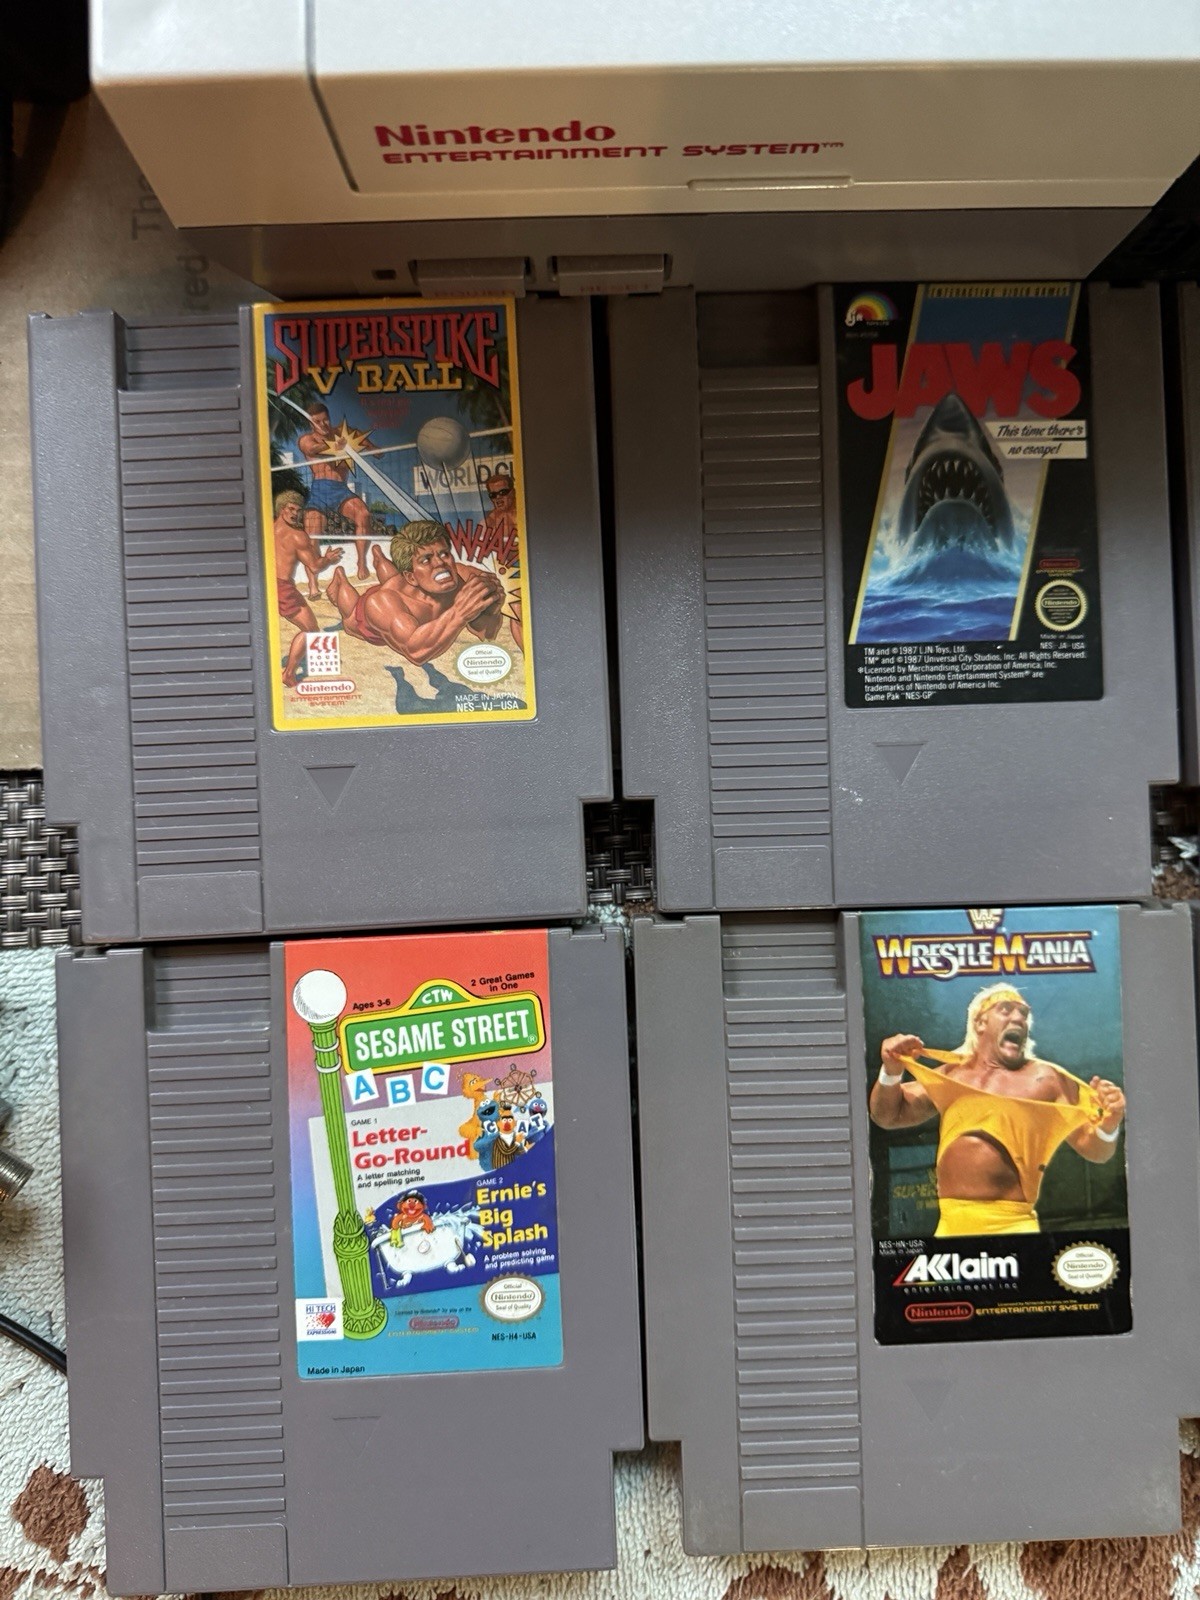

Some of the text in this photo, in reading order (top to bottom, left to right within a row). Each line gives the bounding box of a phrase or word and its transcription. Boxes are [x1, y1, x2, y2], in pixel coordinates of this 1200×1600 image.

[374, 120, 616, 147] Nintendo
[383, 146, 668, 164] ENTERTAINMENT
[846, 340, 1082, 421] JAWS
[997, 424, 1084, 437] This time there's
[1008, 443, 1062, 458] no escape!
[419, 464, 492, 491] WORLD
[864, 647, 875, 656] TM
[881, 656, 895, 665] and
[924, 653, 957, 663] Universal
[959, 654, 972, 663] City
[1004, 652, 1016, 660] Inc.
[1029, 651, 1051, 660] Rights
[1053, 650, 1086, 659] Reserved.
[486, 668, 502, 676] Quality
[907, 664, 959, 674] Merchandising
[961, 661, 1001, 672] Corporation
[1003, 661, 1010, 669] of
[864, 674, 897, 683] Nintendo
[898, 674, 911, 682] and
[914, 673, 945, 681] Nintendo
[947, 670, 997, 680] Entertainment
[301, 684, 352, 693] Nintendo
[864, 679, 1001, 692] trademarks of Nintendo of America Inc.
[455, 691, 519, 702] MADE IN JAPAN
[864, 692, 885, 701] Game
[886, 692, 900, 700] Pak
[876, 934, 1091, 979] WRESTLEMANIA
[479, 976, 503, 985] Great
[505, 971, 535, 981] Games
[489, 984, 498, 992] in
[421, 987, 454, 1005] CTW
[352, 998, 391, 1011] Ages 3-6
[354, 1021, 446, 1062] SESAME
[354, 1066, 445, 1104] A B C
[351, 1118, 371, 1126] GAME
[353, 1126, 428, 1147] Letter-
[354, 1139, 470, 1170] Go-Round
[365, 1171, 384, 1179] letter
[387, 1168, 421, 1177] matching
[374, 1178, 402, 1187] spelling
[405, 1175, 425, 1184] game
[476, 1180, 547, 1205] Ernie's
[478, 1207, 514, 1227] Big
[482, 1223, 548, 1251] Splash
[484, 1248, 546, 1262] A problem solving
[500, 1257, 534, 1268] predicting
[536, 1254, 555, 1263] game
[903, 1284, 994, 1293] entertainment
[316, 1304, 336, 1312] TECH
[910, 1306, 968, 1317] Nintendo
[976, 1305, 1056, 1315] ENTERTAINMENT
[1059, 1303, 1099, 1311] SYSTEM
[492, 1332, 537, 1341] NES-H4-USA
[341, 1365, 365, 1374] Japan
